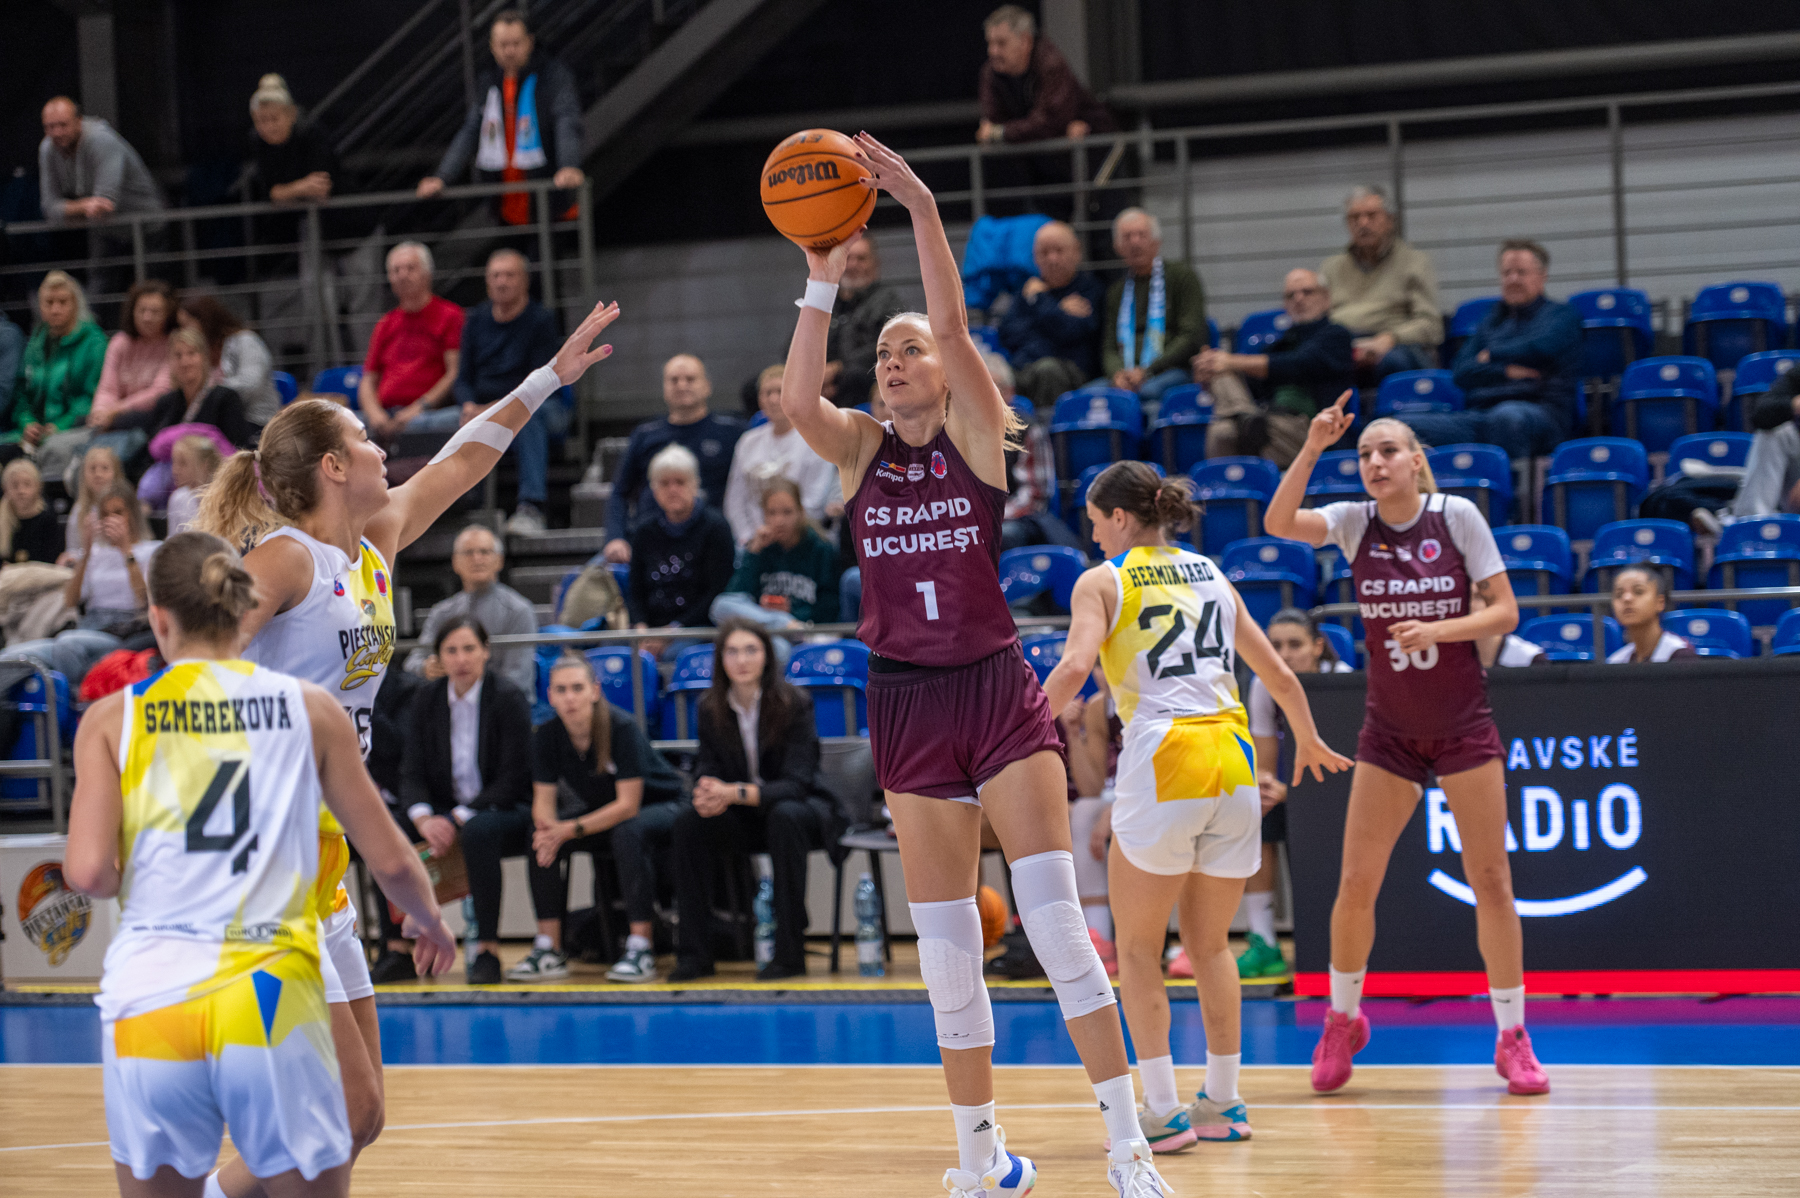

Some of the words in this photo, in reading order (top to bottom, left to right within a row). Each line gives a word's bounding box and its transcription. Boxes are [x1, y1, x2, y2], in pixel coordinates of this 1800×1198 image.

[767, 160, 841, 188] Wilson
[875, 468, 904, 482] Kempa
[865, 506, 891, 526] CS
[896, 497, 971, 525] RAPID
[863, 525, 984, 558] UCUREŞT
[915, 580, 940, 621] 1
[1360, 579, 1386, 596] CS
[1388, 575, 1455, 595] RAPID
[1138, 600, 1232, 680] 24
[1384, 640, 1439, 672] 30
[144, 691, 292, 734] SZMEREKOVÁ
[1506, 727, 1640, 771] AVSKÉ
[185, 760, 259, 876] 4
[1425, 782, 1643, 853] RDIO
